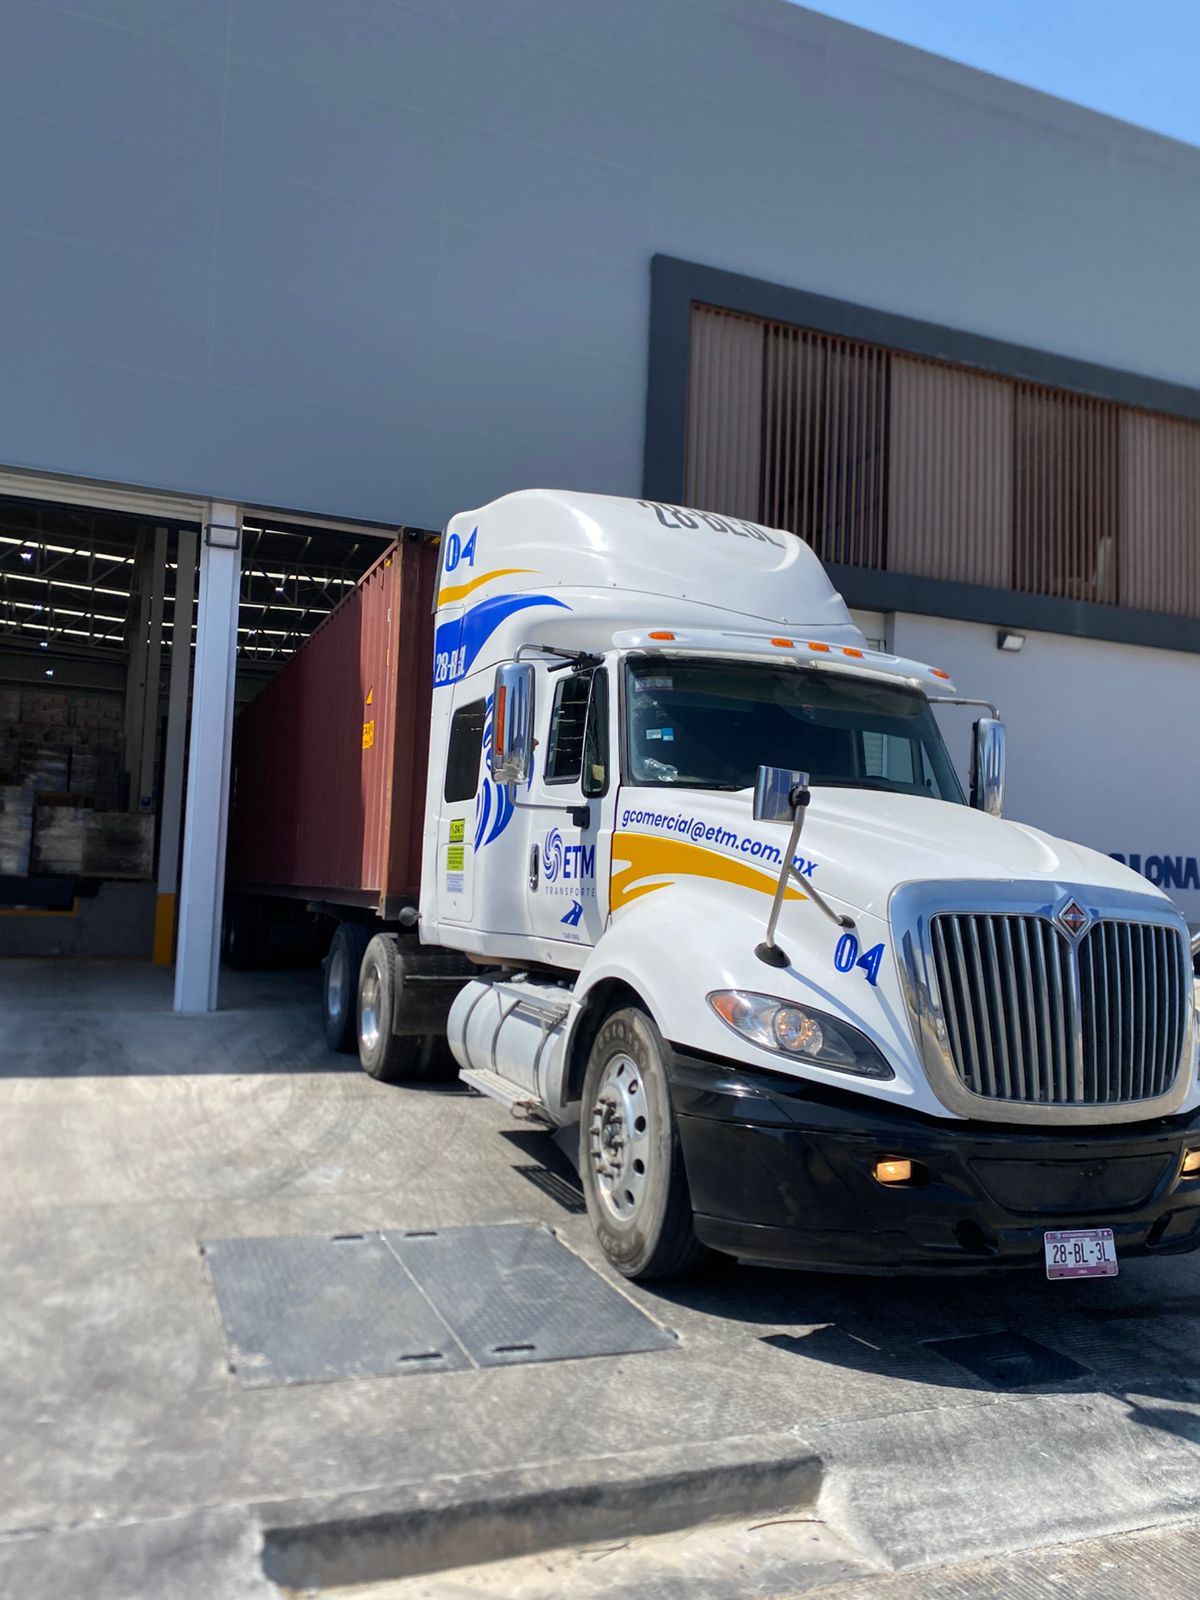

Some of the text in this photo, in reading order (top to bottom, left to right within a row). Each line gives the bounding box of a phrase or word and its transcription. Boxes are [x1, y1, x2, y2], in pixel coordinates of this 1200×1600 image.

[444, 526, 479, 572] 04
[563, 845, 596, 879] ETM
[1107, 852, 1200, 890] IONA
[545, 886, 597, 898] TRANSPORTE
[833, 933, 886, 987] 04
[1052, 1241, 1110, 1264] 28-BL-3L
